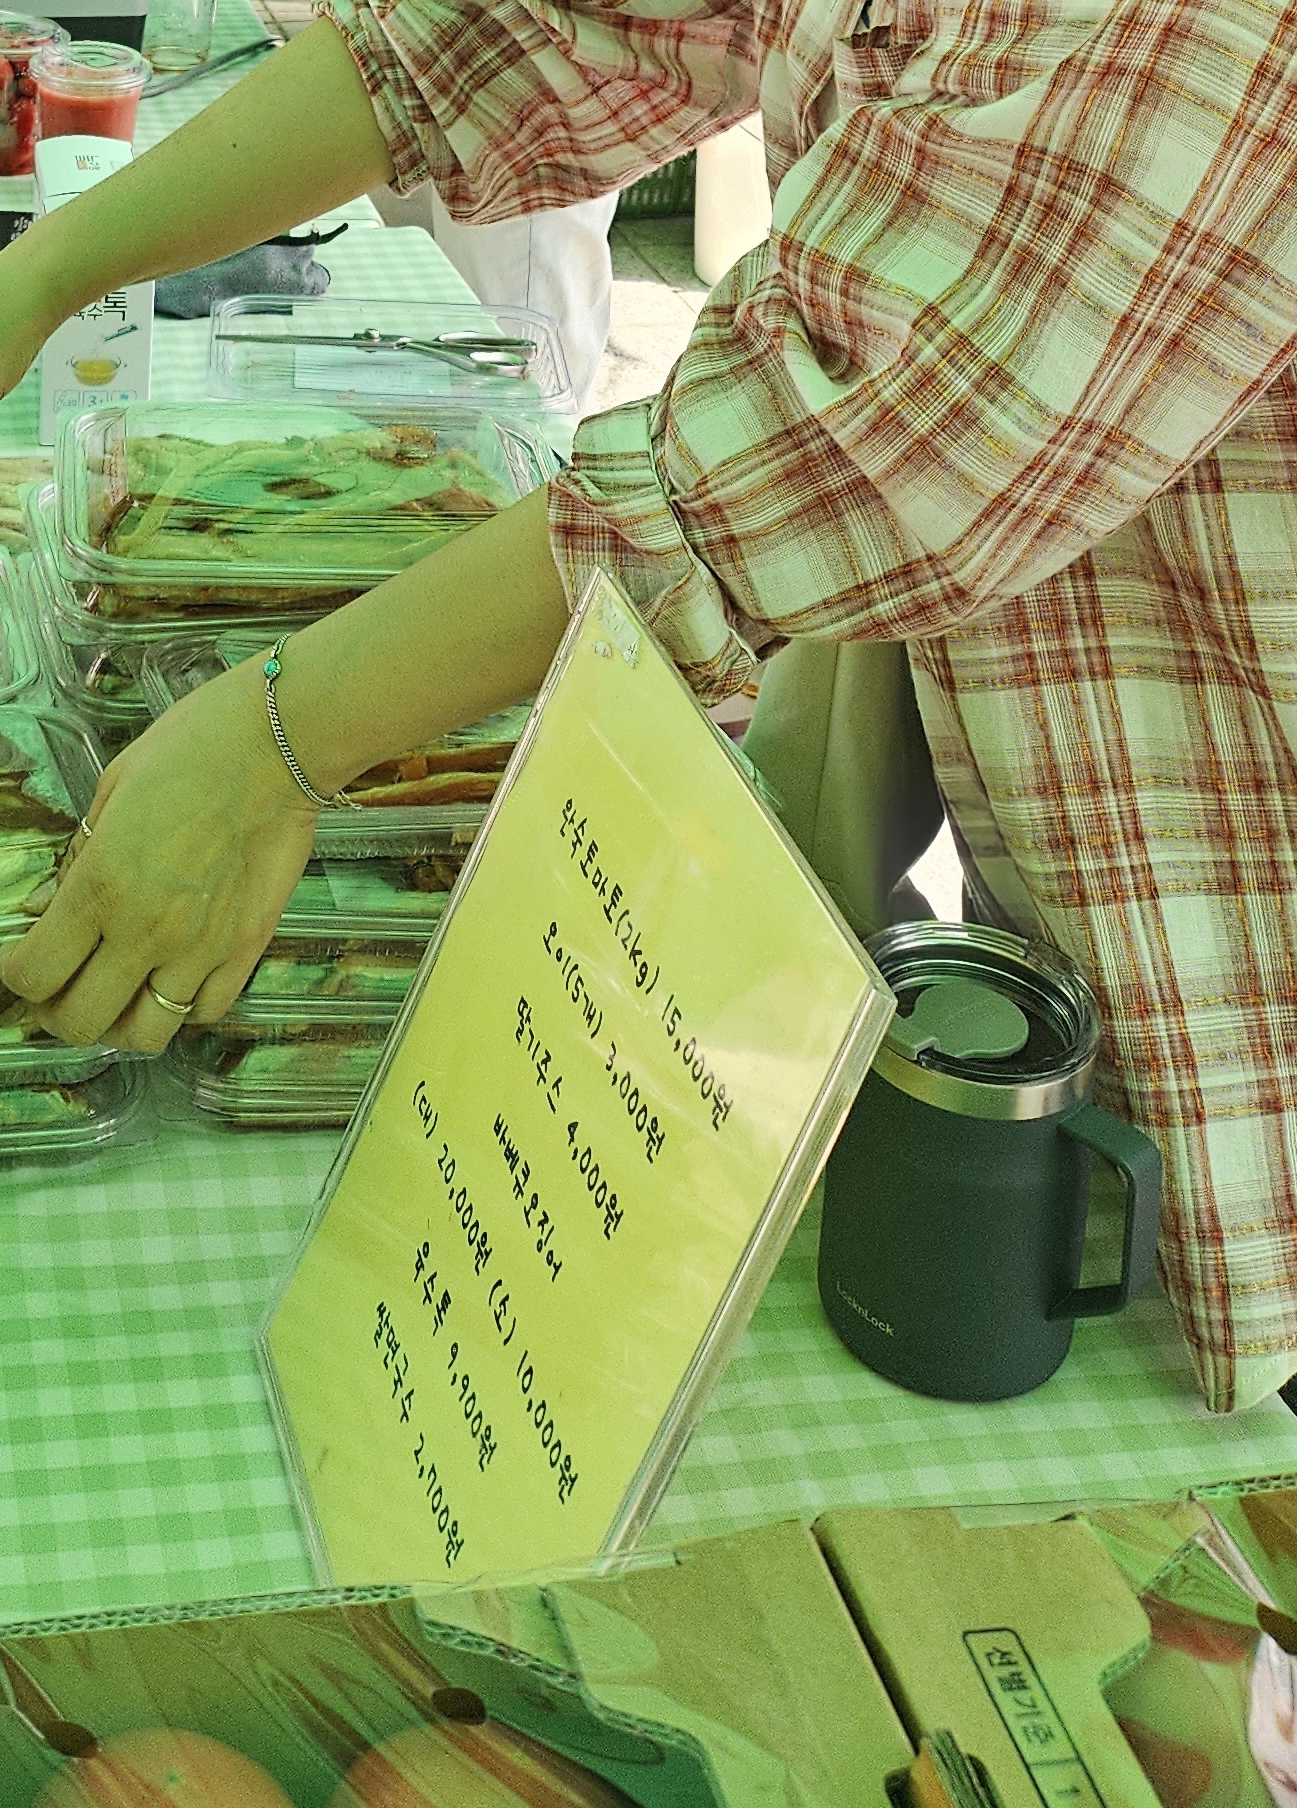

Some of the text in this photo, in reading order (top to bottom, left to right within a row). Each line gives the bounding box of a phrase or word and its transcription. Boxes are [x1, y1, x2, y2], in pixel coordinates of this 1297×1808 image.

[543, 922, 666, 1164] 오이(5개) 3,000원
[560, 798, 734, 1132] 완숙토마토(2kg) 15,000원
[515, 996, 625, 1241] 딸기주스 4,000원
[412, 1080, 579, 1504] (대) 20,000원 (소) 10,000원
[413, 1242, 498, 1472] 육수톡 9,900원
[374, 1302, 465, 1568] 쌀면국수 2,700원
[985, 1647, 1055, 1745] 선별기준
